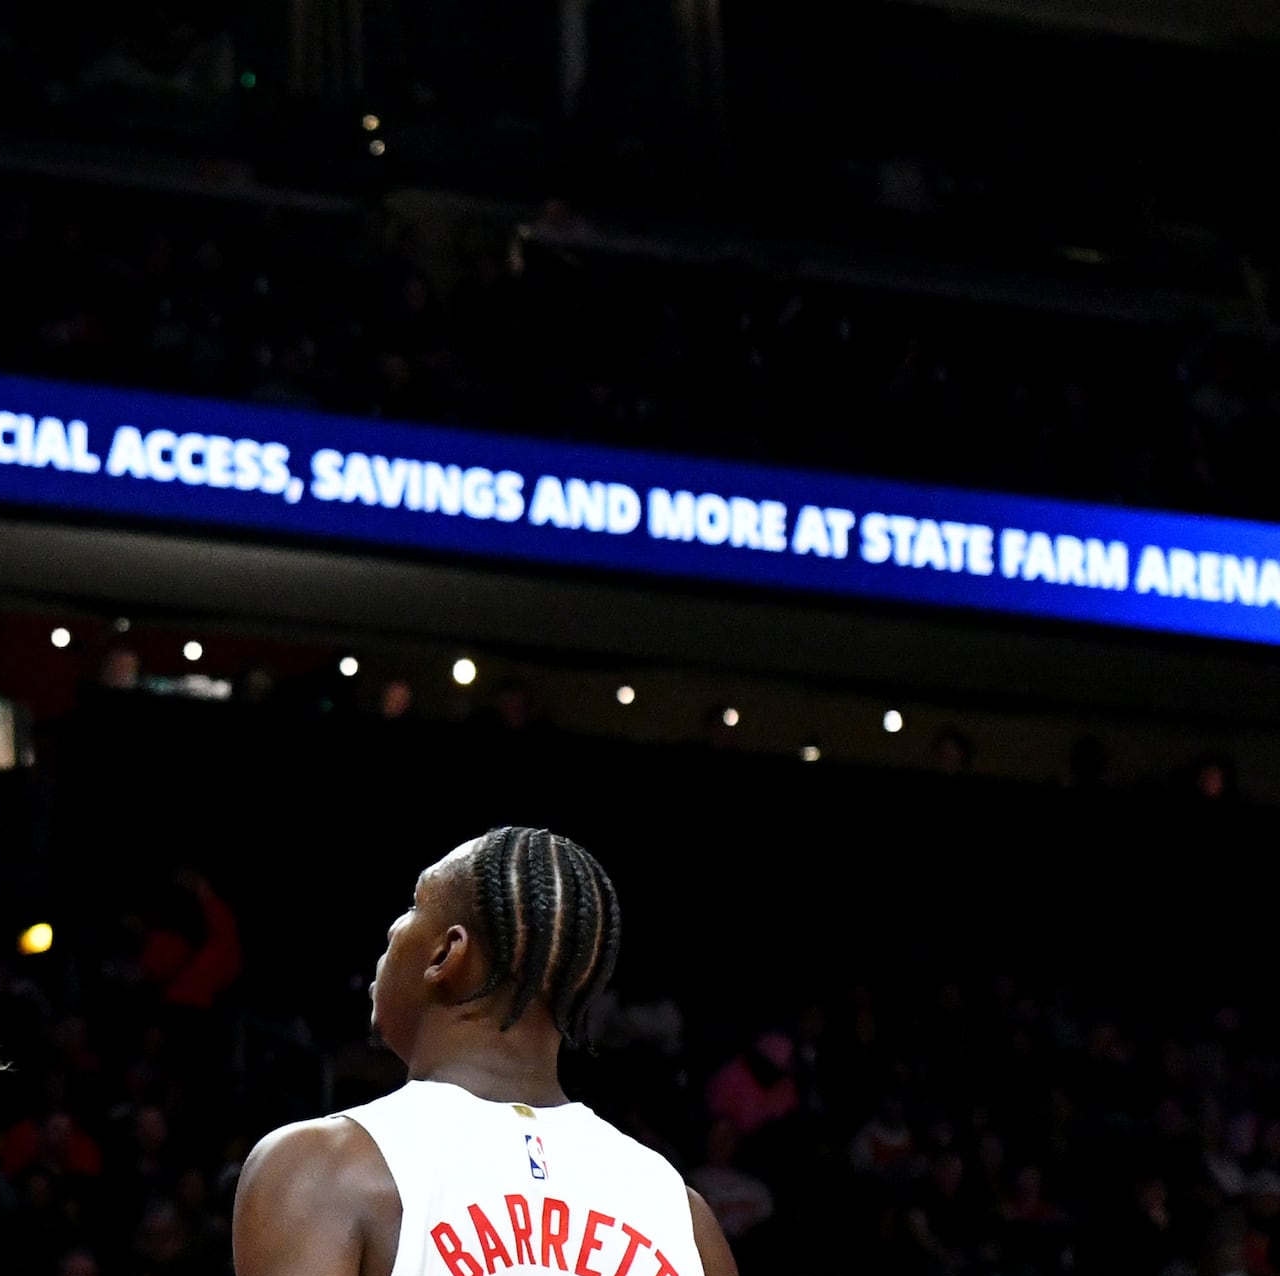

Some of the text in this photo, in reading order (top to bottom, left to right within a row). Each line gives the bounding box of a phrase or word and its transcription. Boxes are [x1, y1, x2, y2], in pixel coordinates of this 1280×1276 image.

[107, 426, 304, 504] ACCESS,
[311, 449, 525, 522] SAVINGS
[530, 477, 642, 534] AND
[649, 489, 787, 552] MORE
[793, 506, 856, 559] AT
[862, 513, 994, 576] STATE
[1001, 530, 1129, 591] FARM
[1135, 545, 1280, 608] ARENA
